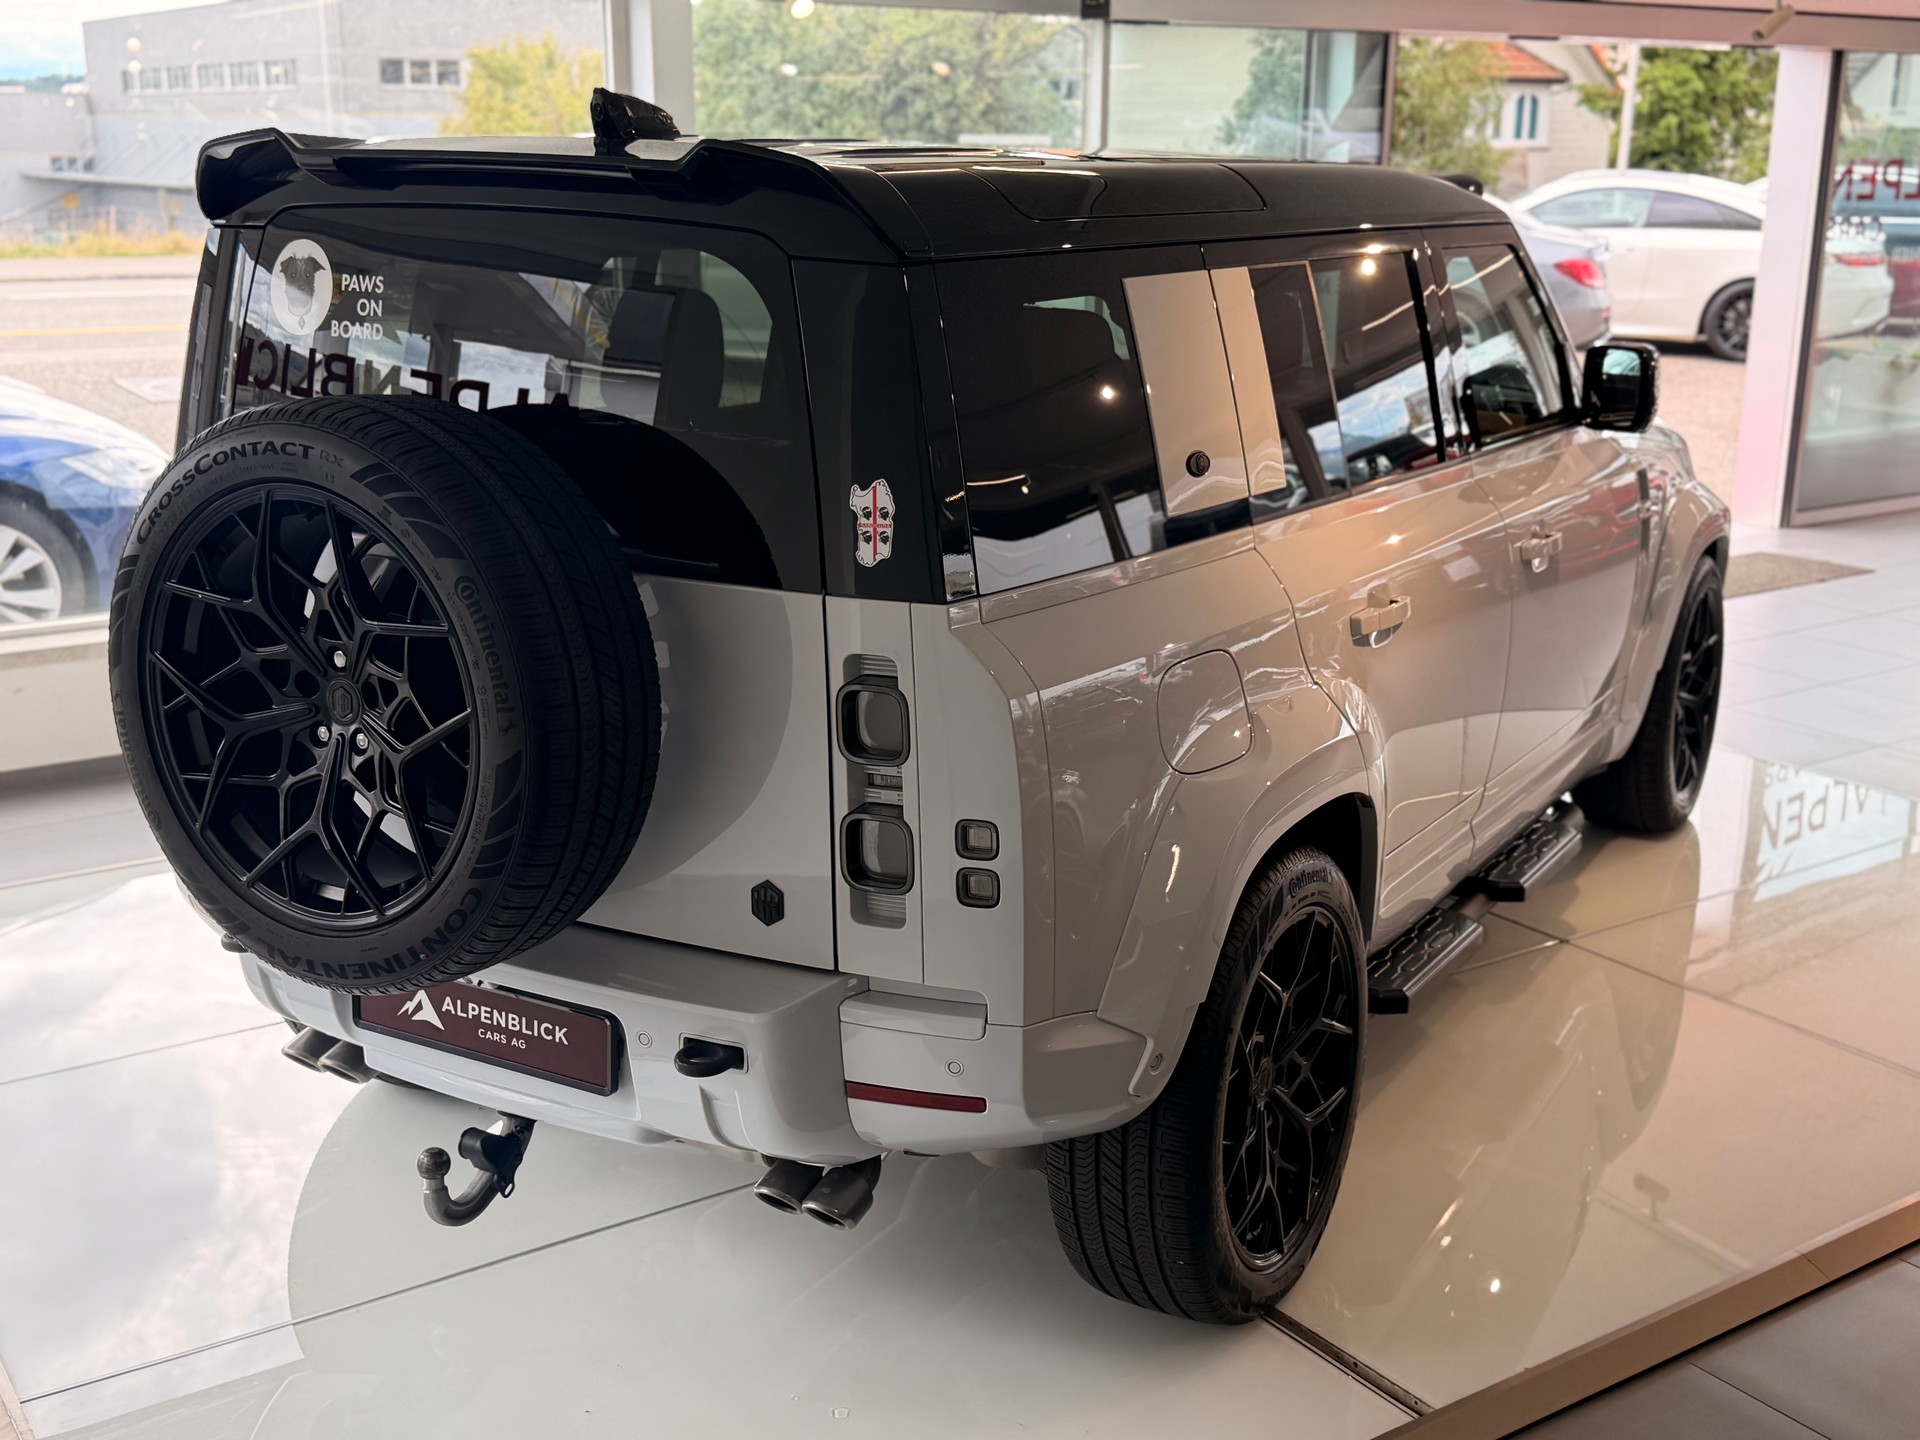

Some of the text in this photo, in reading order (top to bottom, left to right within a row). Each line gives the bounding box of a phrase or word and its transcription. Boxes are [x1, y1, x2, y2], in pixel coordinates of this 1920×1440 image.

[340, 274, 384, 294] PAWS
[356, 298, 383, 317] ON
[331, 320, 383, 340] BOARD
[319, 449, 345, 469] RX
[454, 575, 516, 715] Continental
[1288, 866, 1330, 898] Continental
[257, 887, 483, 981] CONTINENTAL
[441, 995, 569, 1046] ALPENBLICK
[478, 1028, 527, 1050] CARS AG
